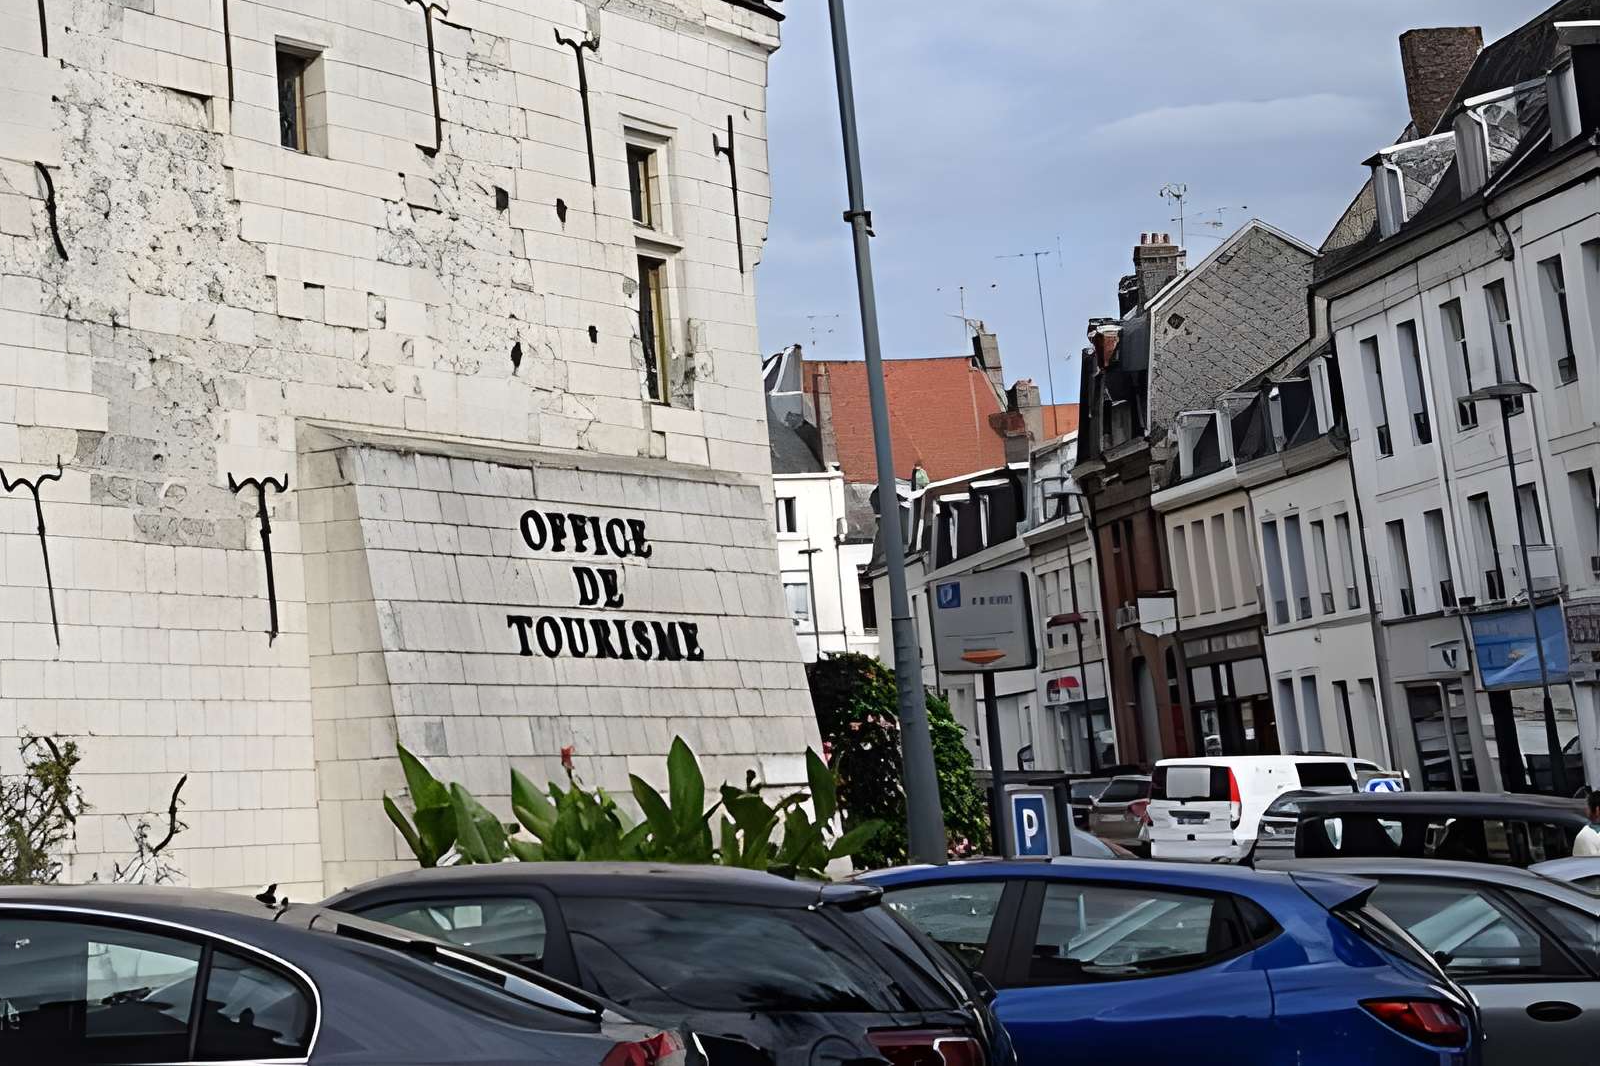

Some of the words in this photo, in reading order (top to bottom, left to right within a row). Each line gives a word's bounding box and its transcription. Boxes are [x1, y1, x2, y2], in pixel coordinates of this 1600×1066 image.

[519, 509, 652, 559] OFFICE
[572, 566, 625, 609] DE
[506, 614, 705, 662] TOURISME
[1022, 808, 1039, 848] P
